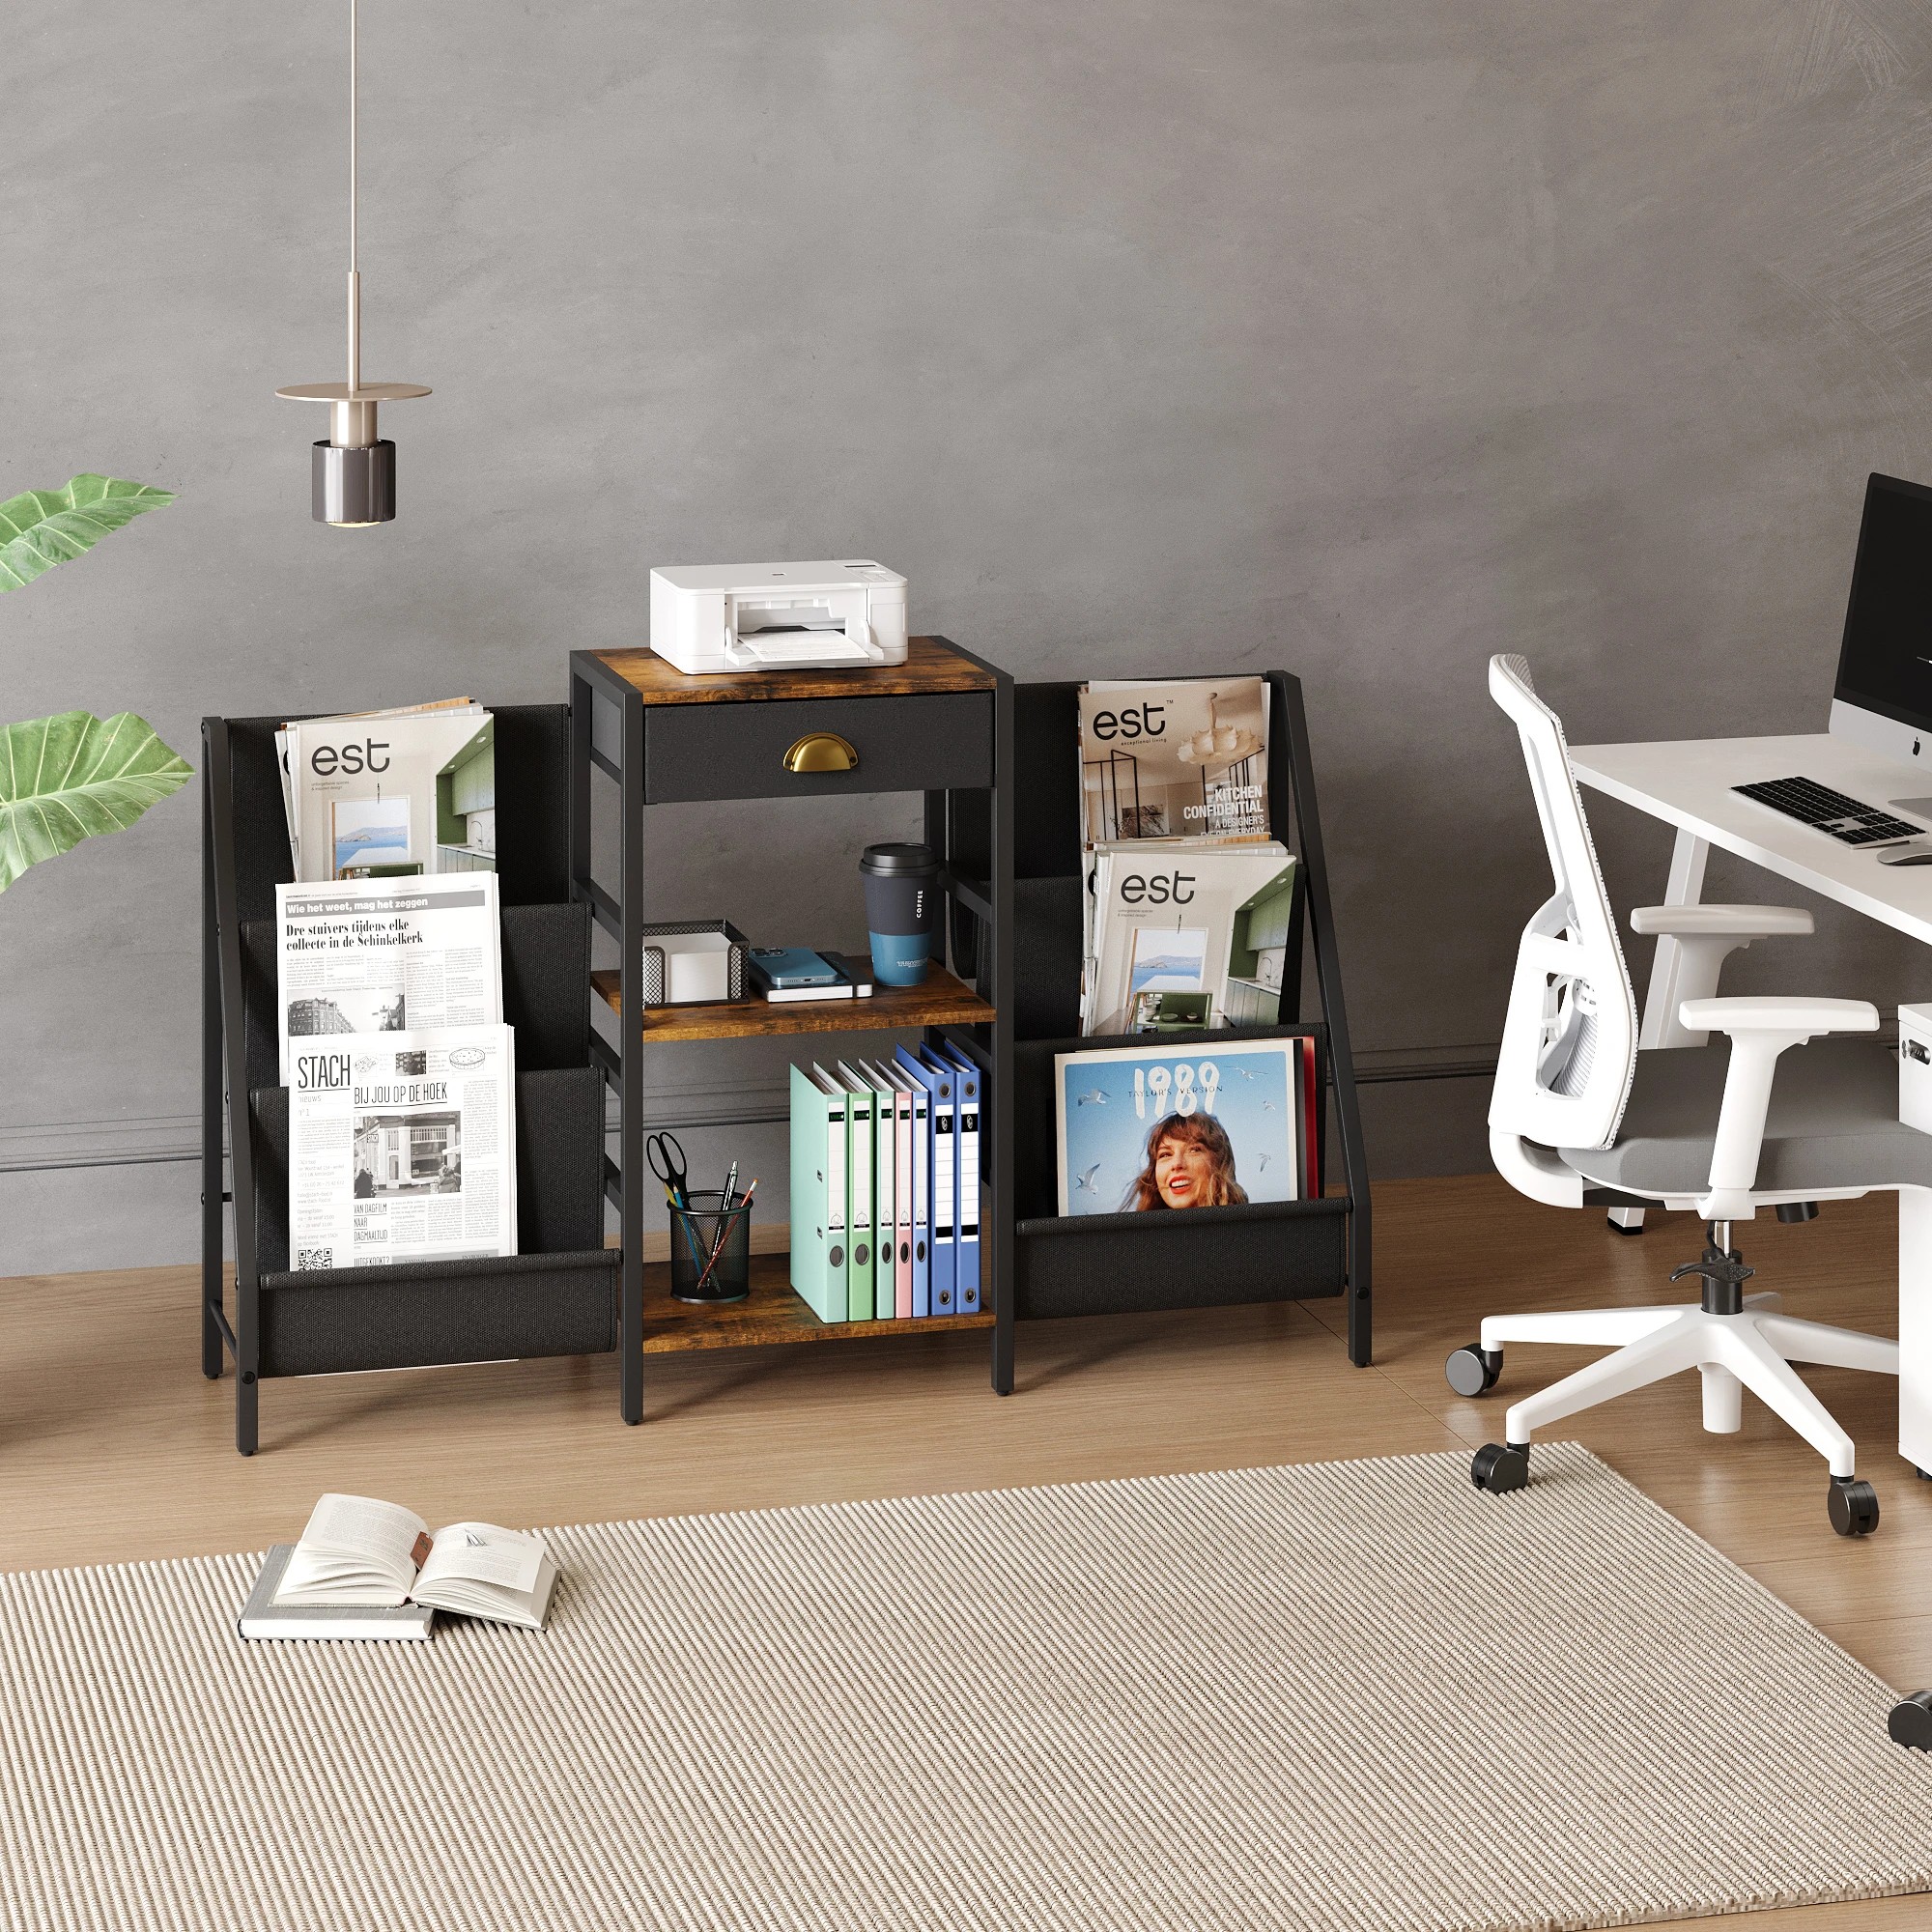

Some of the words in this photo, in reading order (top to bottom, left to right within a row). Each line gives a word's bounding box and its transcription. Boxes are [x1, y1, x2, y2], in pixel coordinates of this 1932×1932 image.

[1093, 702, 1166, 740] est
[311, 738, 390, 776] est
[1214, 784, 1263, 802] KITCHEN
[1183, 800, 1264, 819] CONFIDENTIAL
[1215, 818, 1221, 829] A
[1222, 814, 1264, 828] DESIGNER'S
[1121, 870, 1196, 904] est
[286, 904, 305, 914] Wie
[306, 903, 323, 913] het
[325, 901, 353, 912] weet,
[354, 901, 376, 911] mag
[377, 899, 393, 909] het
[394, 898, 429, 908] zeggen
[286, 924, 305, 936] Dre
[308, 922, 349, 935] stuivers
[352, 920, 386, 935] tijdens
[388, 918, 410, 930] elke
[286, 938, 327, 951] collecte
[329, 936, 339, 948] in
[343, 935, 355, 948] de
[357, 930, 423, 947] Schinkelkerk
[298, 1054, 351, 1089] STACH
[298, 1094, 322, 1103] nieuws
[354, 1086, 369, 1104] BIJ
[371, 1085, 390, 1103] JOU
[393, 1085, 407, 1102] OP
[409, 1084, 421, 1102] DE
[423, 1082, 447, 1101] HOEK
[1127, 1088, 1172, 1098] TAYLOR'S
[1179, 1086, 1223, 1094] VERSION
[1134, 1061, 1220, 1120] 1989
[354, 1204, 364, 1214] VAN
[364, 1203, 387, 1213] DAGFILM
[354, 1216, 368, 1228] NAAR
